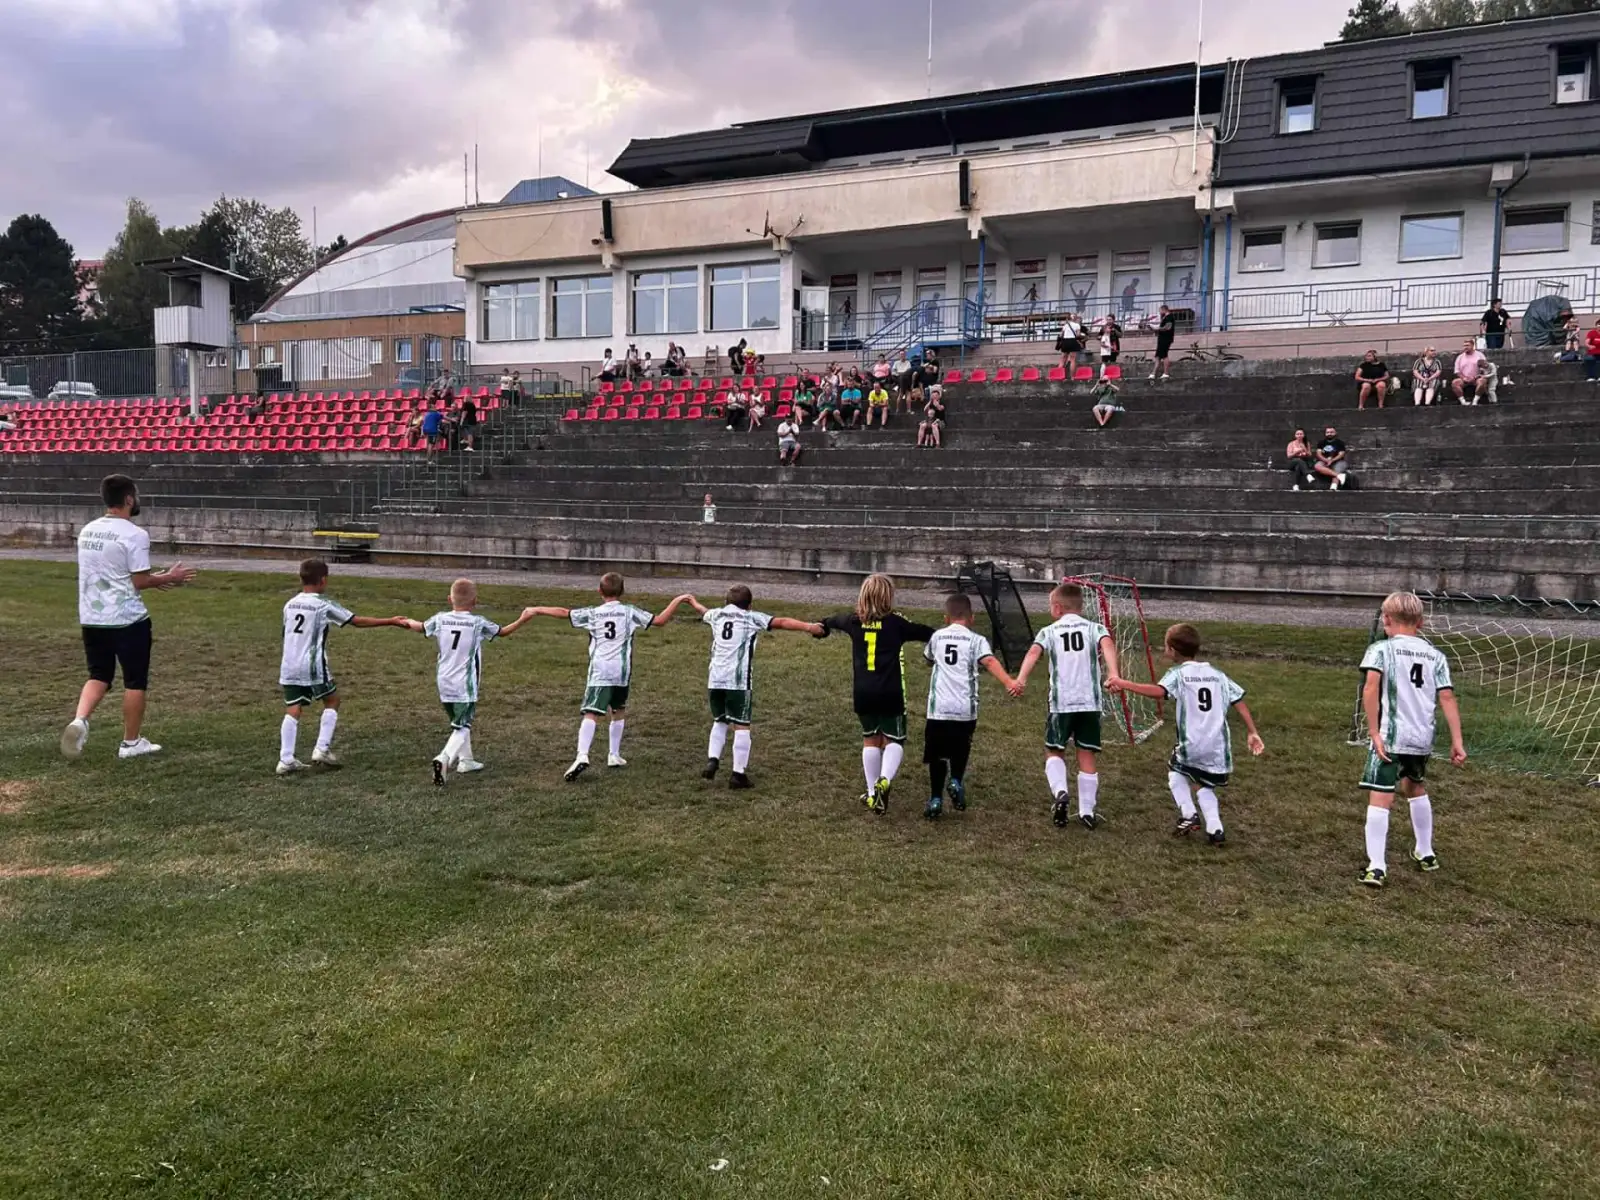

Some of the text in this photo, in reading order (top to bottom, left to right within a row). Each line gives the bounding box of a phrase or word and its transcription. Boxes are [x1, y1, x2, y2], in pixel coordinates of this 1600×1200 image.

[294, 614, 305, 633] 2
[605, 621, 616, 640] 3
[722, 621, 733, 640] 8
[451, 630, 461, 650] 7
[1060, 631, 1084, 652] 10
[864, 632, 876, 671] 1
[945, 644, 958, 665] 5
[1410, 663, 1424, 688] 4
[1198, 687, 1212, 712] 9
